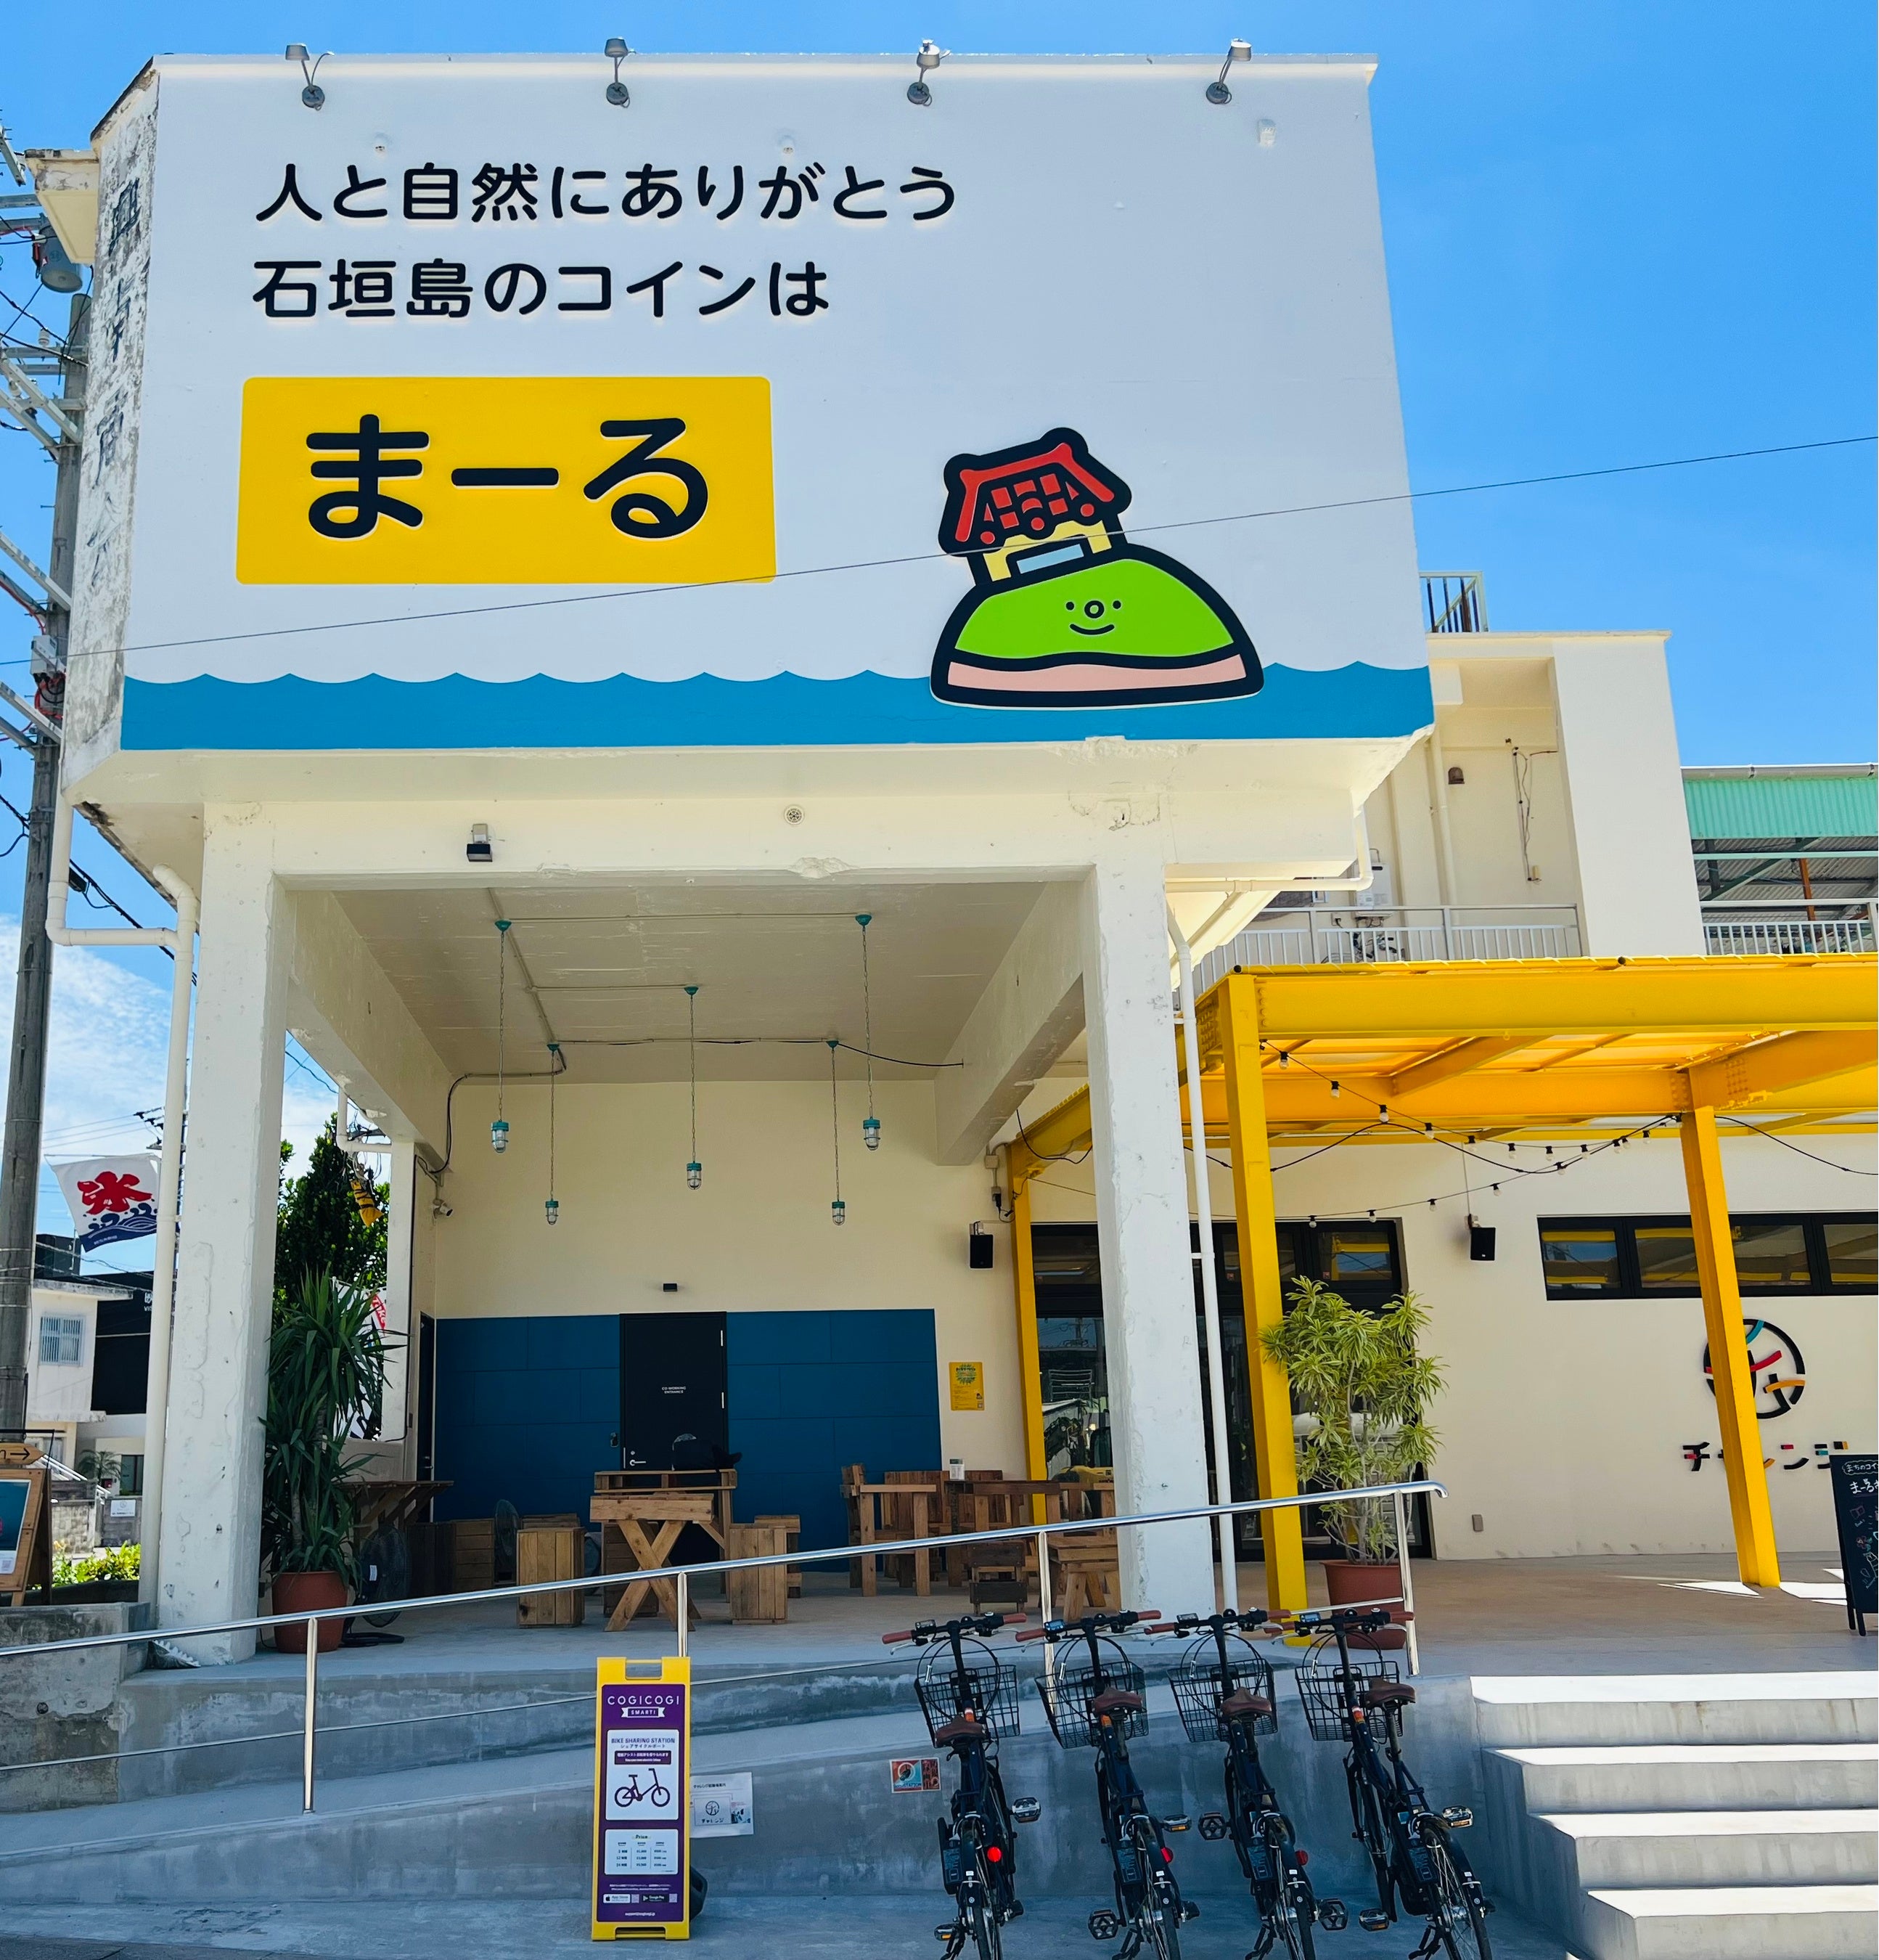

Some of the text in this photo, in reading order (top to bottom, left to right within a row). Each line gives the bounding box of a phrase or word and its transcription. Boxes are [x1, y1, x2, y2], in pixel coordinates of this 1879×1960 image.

[255, 162, 954, 223] 人と自然にありがとう
[253, 258, 829, 318] 石垣島のコインは
[306, 414, 708, 539] まーる
[77, 1171, 152, 1215] 氷
[1846, 1463, 1878, 1472] まちのコイ
[607, 1696, 679, 1704] COGICOGI
